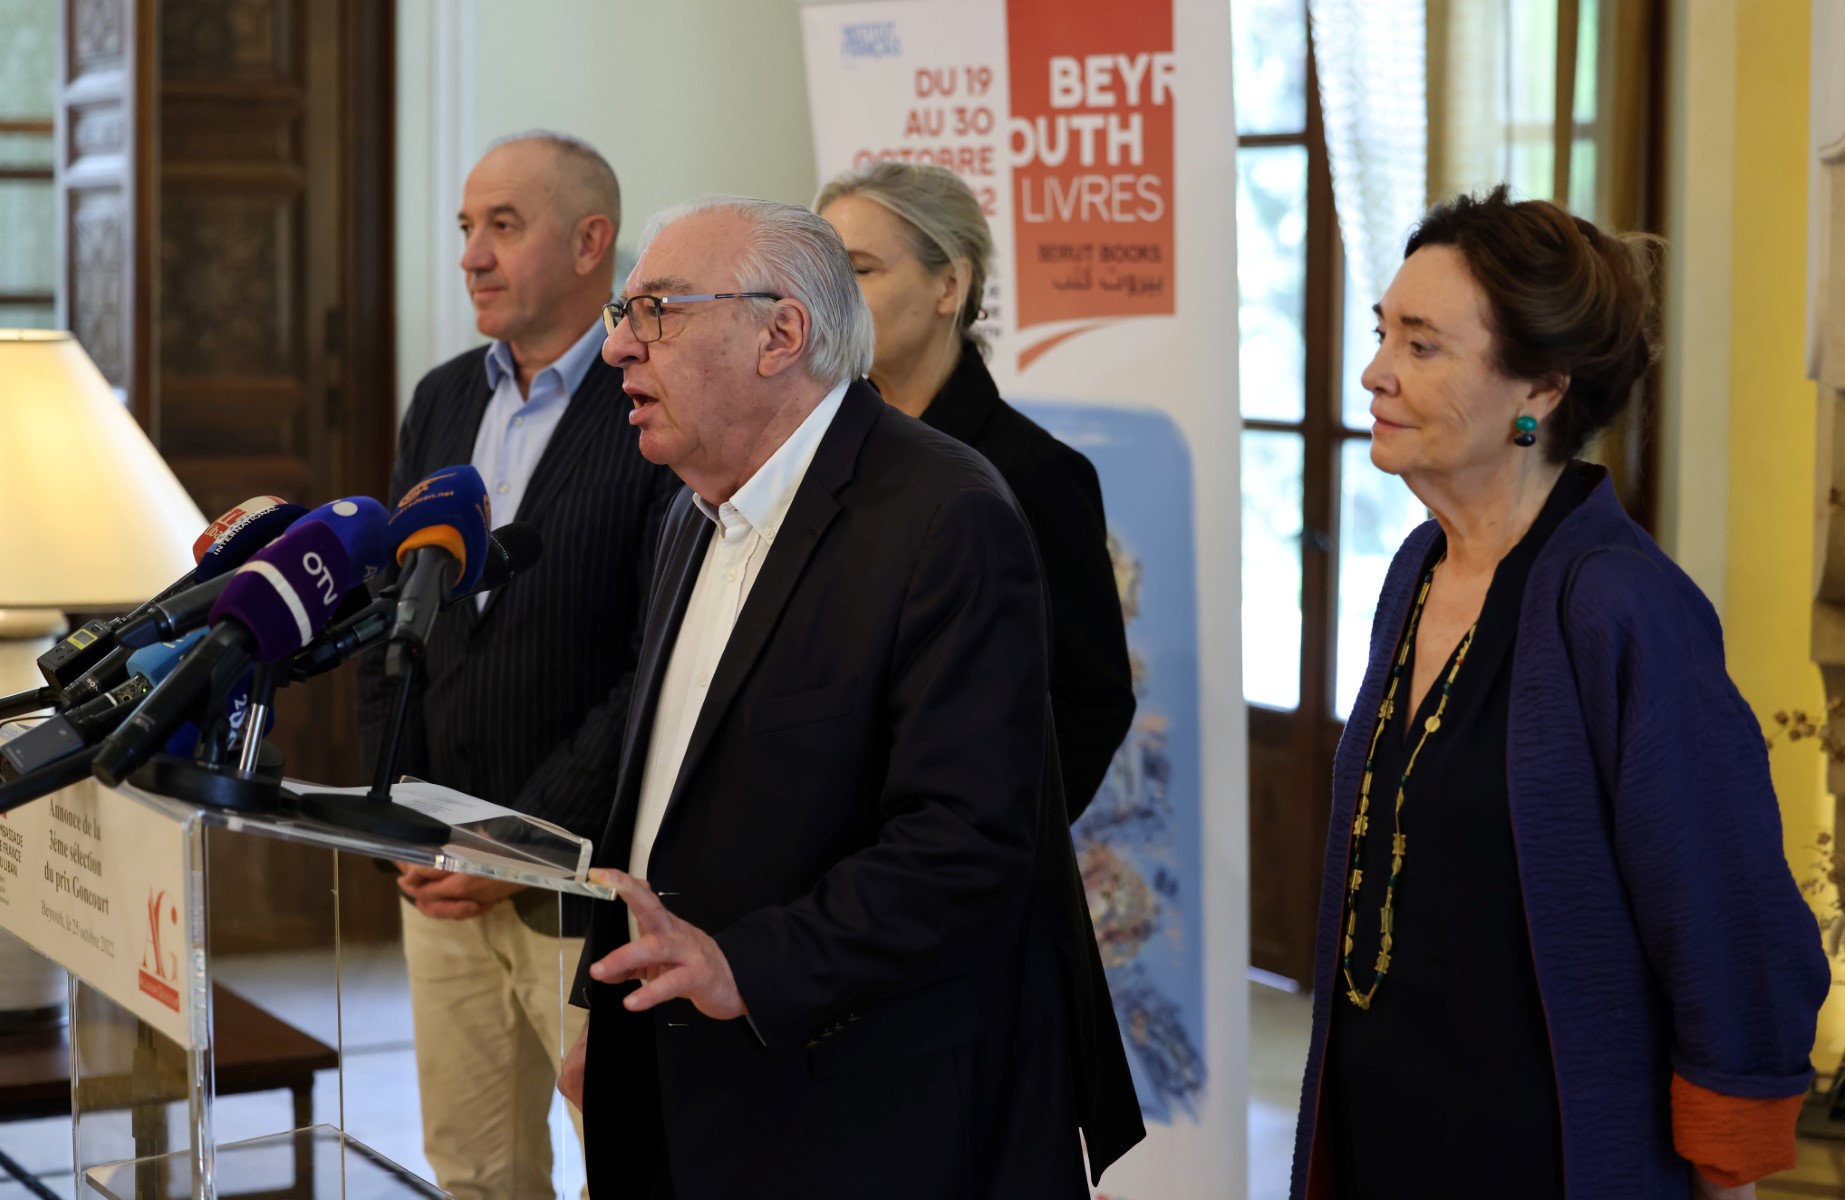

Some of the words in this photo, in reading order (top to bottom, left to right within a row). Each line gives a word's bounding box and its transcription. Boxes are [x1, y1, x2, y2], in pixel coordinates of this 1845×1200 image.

[914, 68, 957, 98] DU
[963, 66, 992, 96] 19
[1049, 52, 1175, 109] BEYR
[904, 108, 944, 138] AU
[953, 106, 995, 136] 30
[1008, 113, 1143, 168] OUTH
[1022, 174, 1164, 222] LIVRES
[1100, 243, 1162, 263] BOOKS
[213, 504, 279, 556] INTERNATIONAL
[303, 552, 338, 606] OTV
[49, 797, 81, 831] Annonce
[82, 813, 92, 837] de
[69, 841, 102, 877] sélection
[44, 860, 54, 884] du
[55, 870, 71, 893] prix
[72, 875, 109, 915] Goncourt
